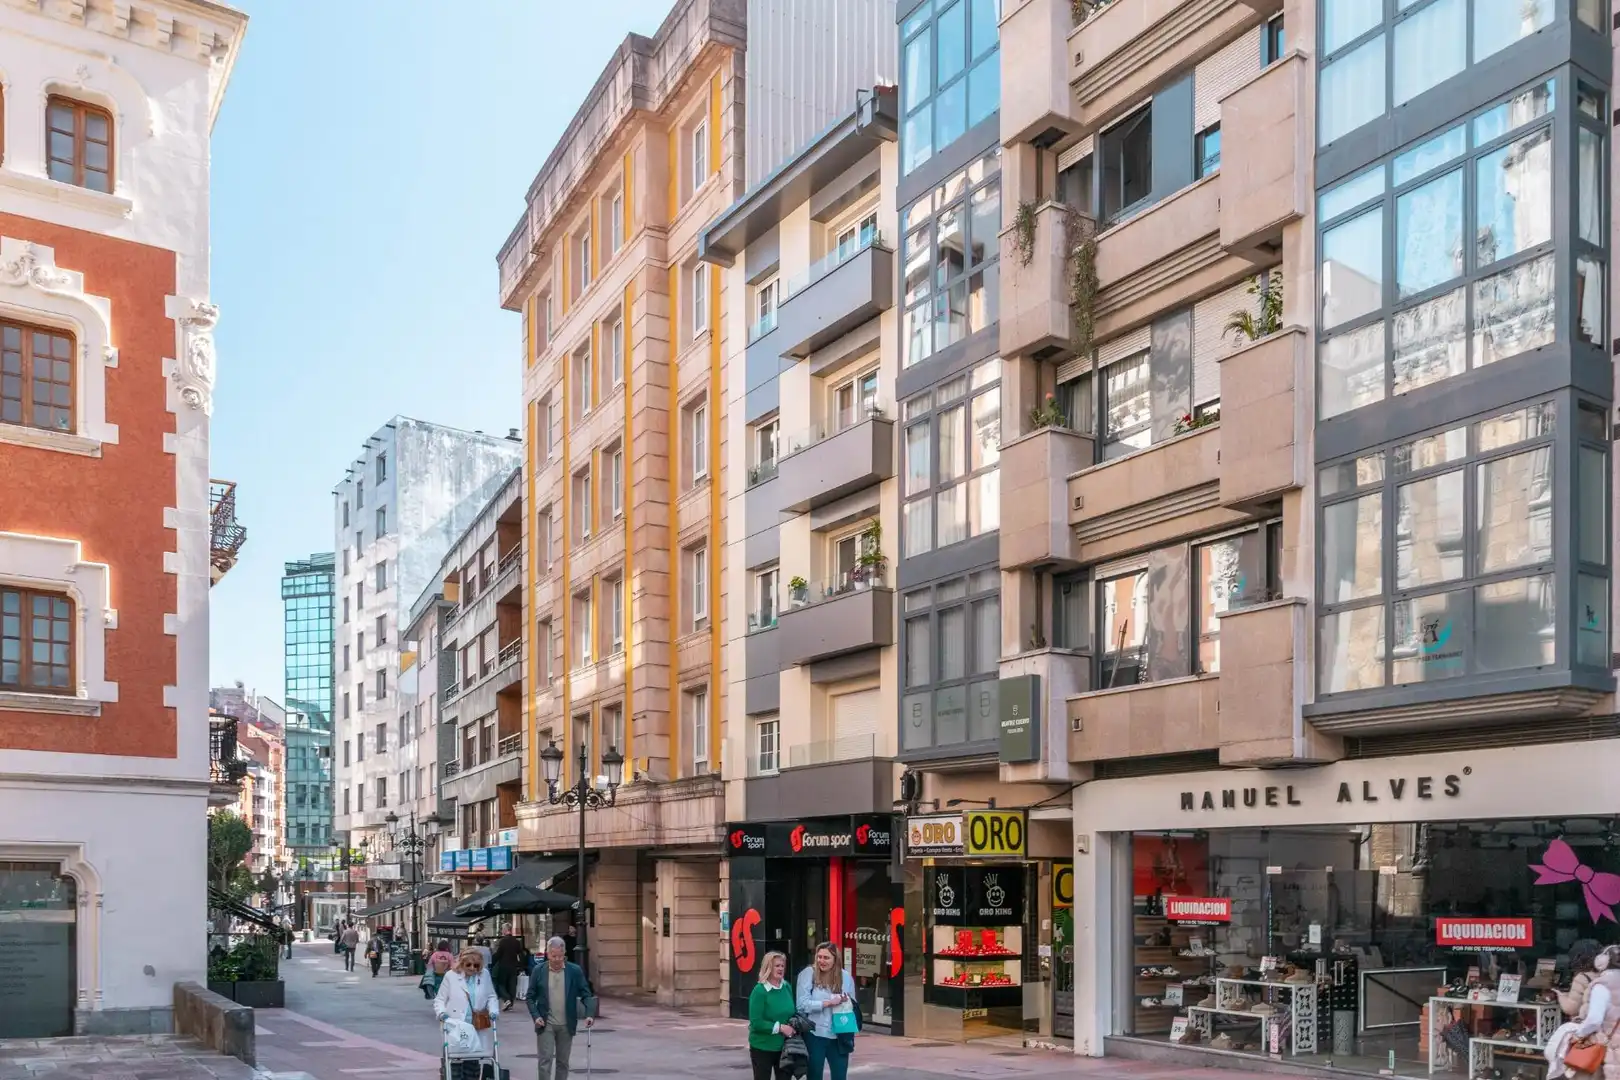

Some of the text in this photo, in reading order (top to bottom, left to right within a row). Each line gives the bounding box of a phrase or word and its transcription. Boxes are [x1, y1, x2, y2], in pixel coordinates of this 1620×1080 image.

[1180, 785, 1301, 811] MANUEL
[922, 821, 956, 844] ORO
[970, 815, 1022, 851] ORO
[979, 908, 994, 916] ORO
[1171, 901, 1227, 915] LIQUIDACION
[1442, 923, 1526, 940] LIQUIDACION
